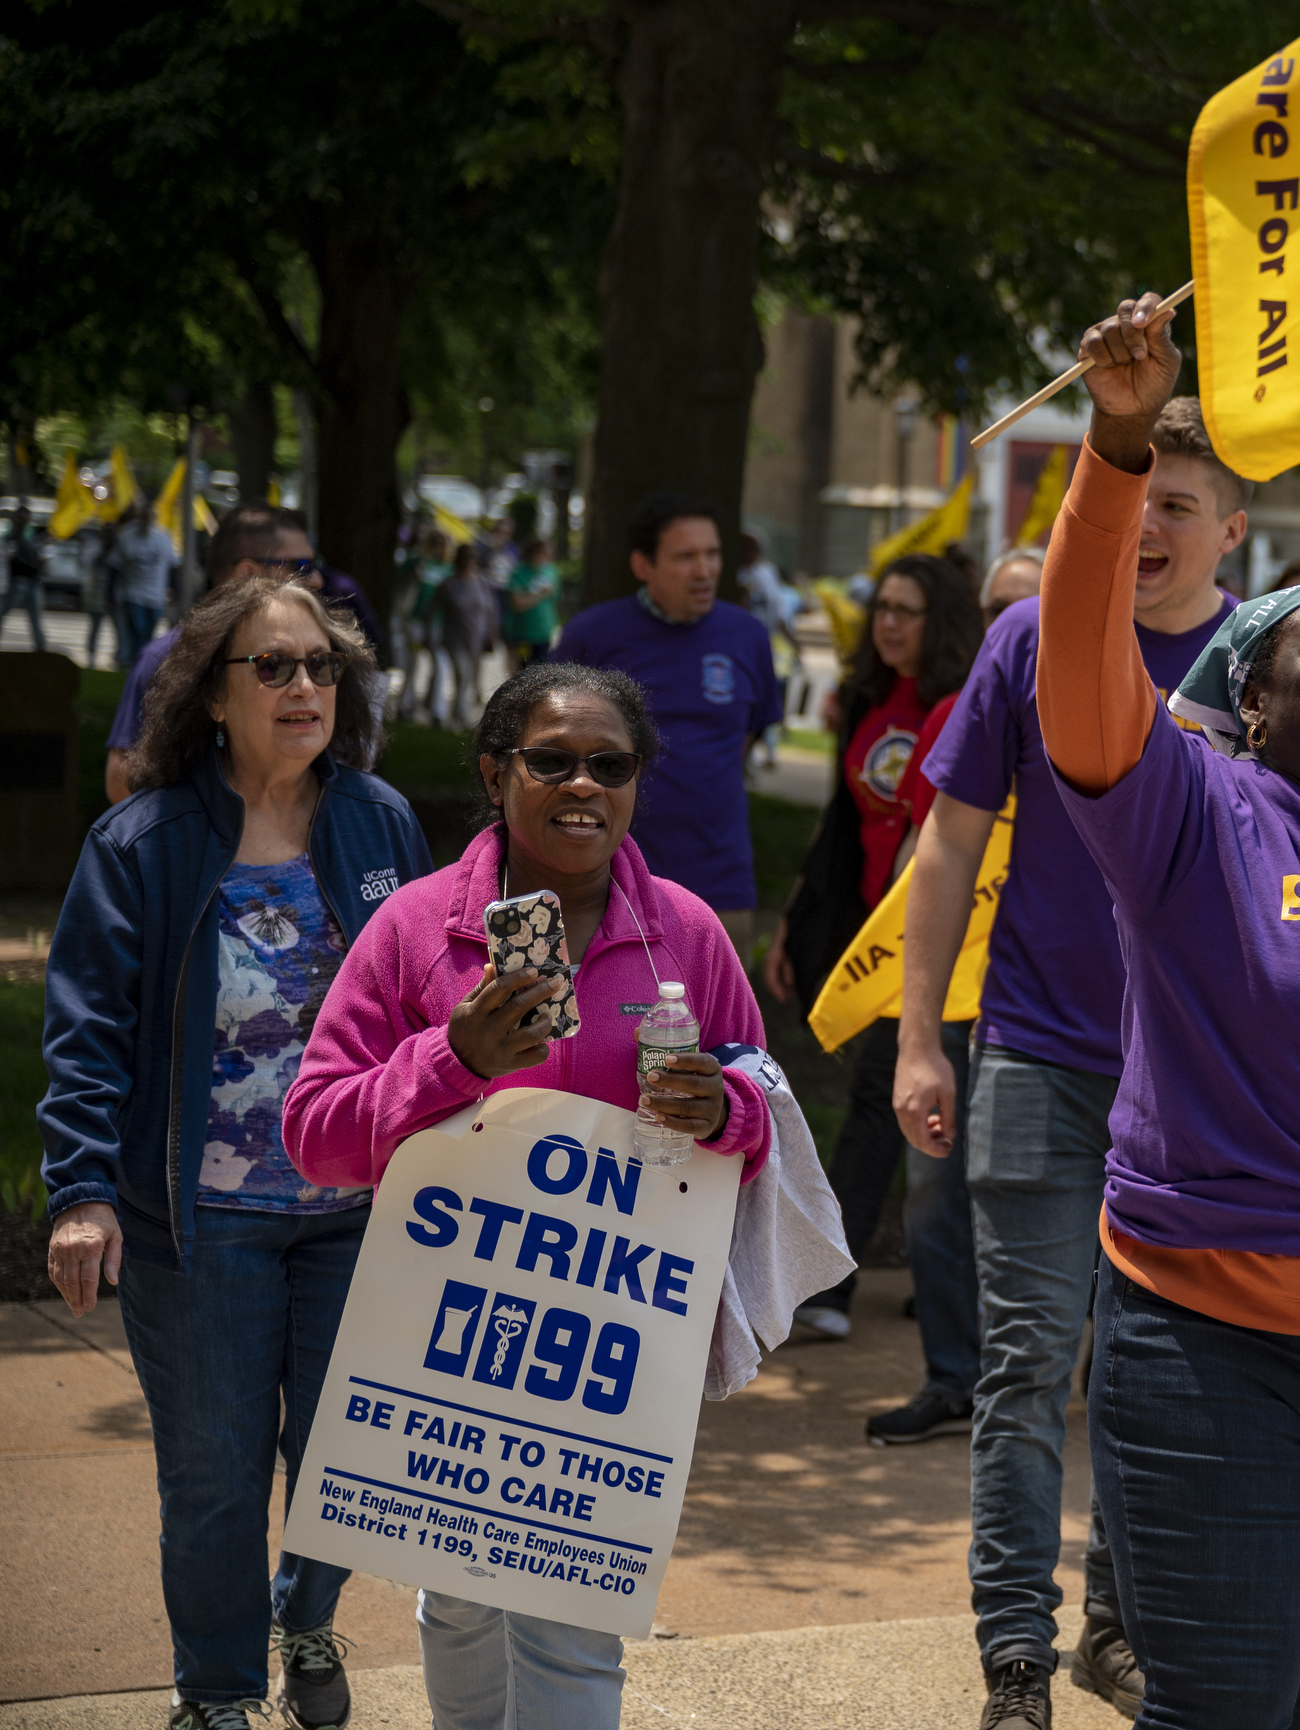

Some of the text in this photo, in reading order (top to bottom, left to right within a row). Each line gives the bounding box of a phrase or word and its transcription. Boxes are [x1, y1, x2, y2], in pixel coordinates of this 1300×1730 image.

[1255, 176, 1300, 278] For
[1245, 598, 1278, 629] ALL
[363, 867, 396, 882] UConn
[643, 1060, 666, 1071] Sprin
[526, 1134, 643, 1216] ON
[405, 1185, 695, 1317] STRIKE
[345, 1394, 665, 1499] BE FAIR TO THOSE
[407, 1450, 597, 1522] WHO CARE
[319, 1478, 647, 1575] New England Health Care Employees Union
[320, 1502, 636, 1595] District 1199, SEIU/AFL-CIO
